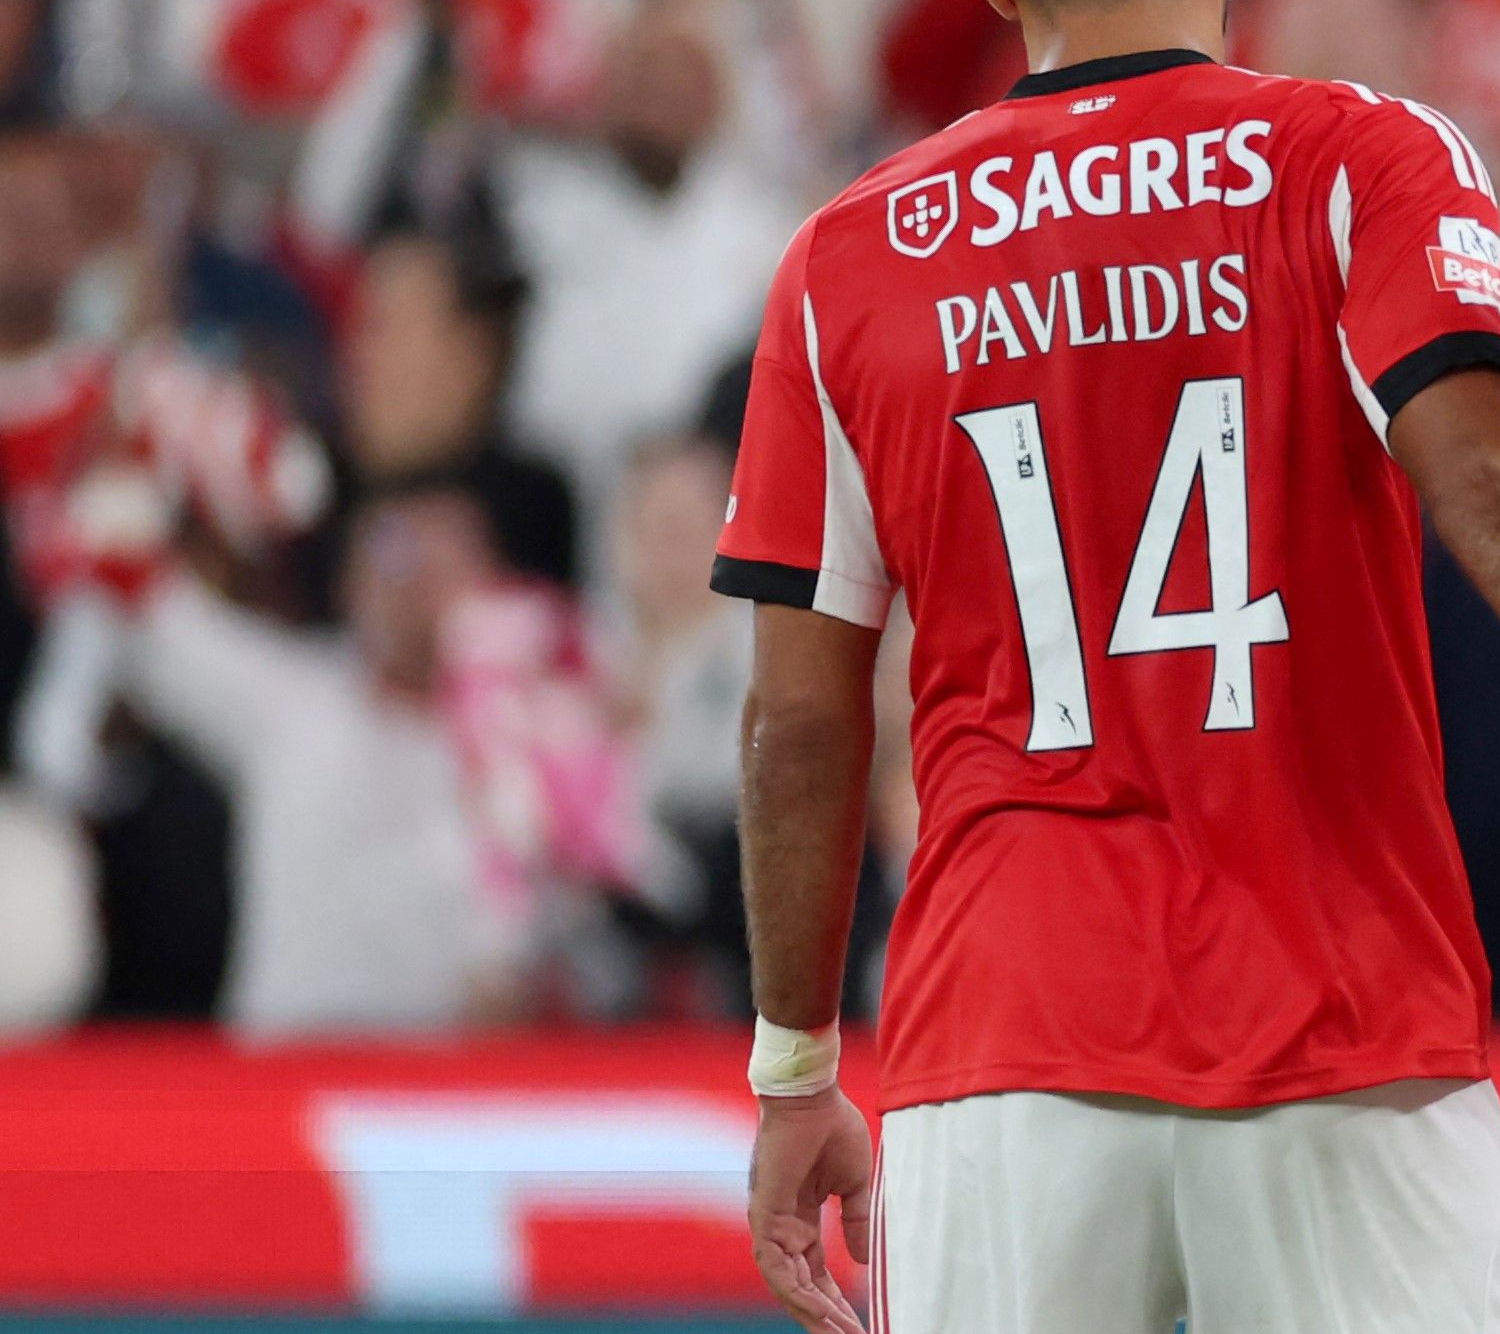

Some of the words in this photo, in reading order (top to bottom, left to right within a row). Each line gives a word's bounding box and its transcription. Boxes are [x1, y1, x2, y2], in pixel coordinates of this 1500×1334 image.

[969, 120, 1273, 247] SAGRES
[935, 253, 1249, 374] PAVLIDIS
[953, 376, 1290, 754] 14
